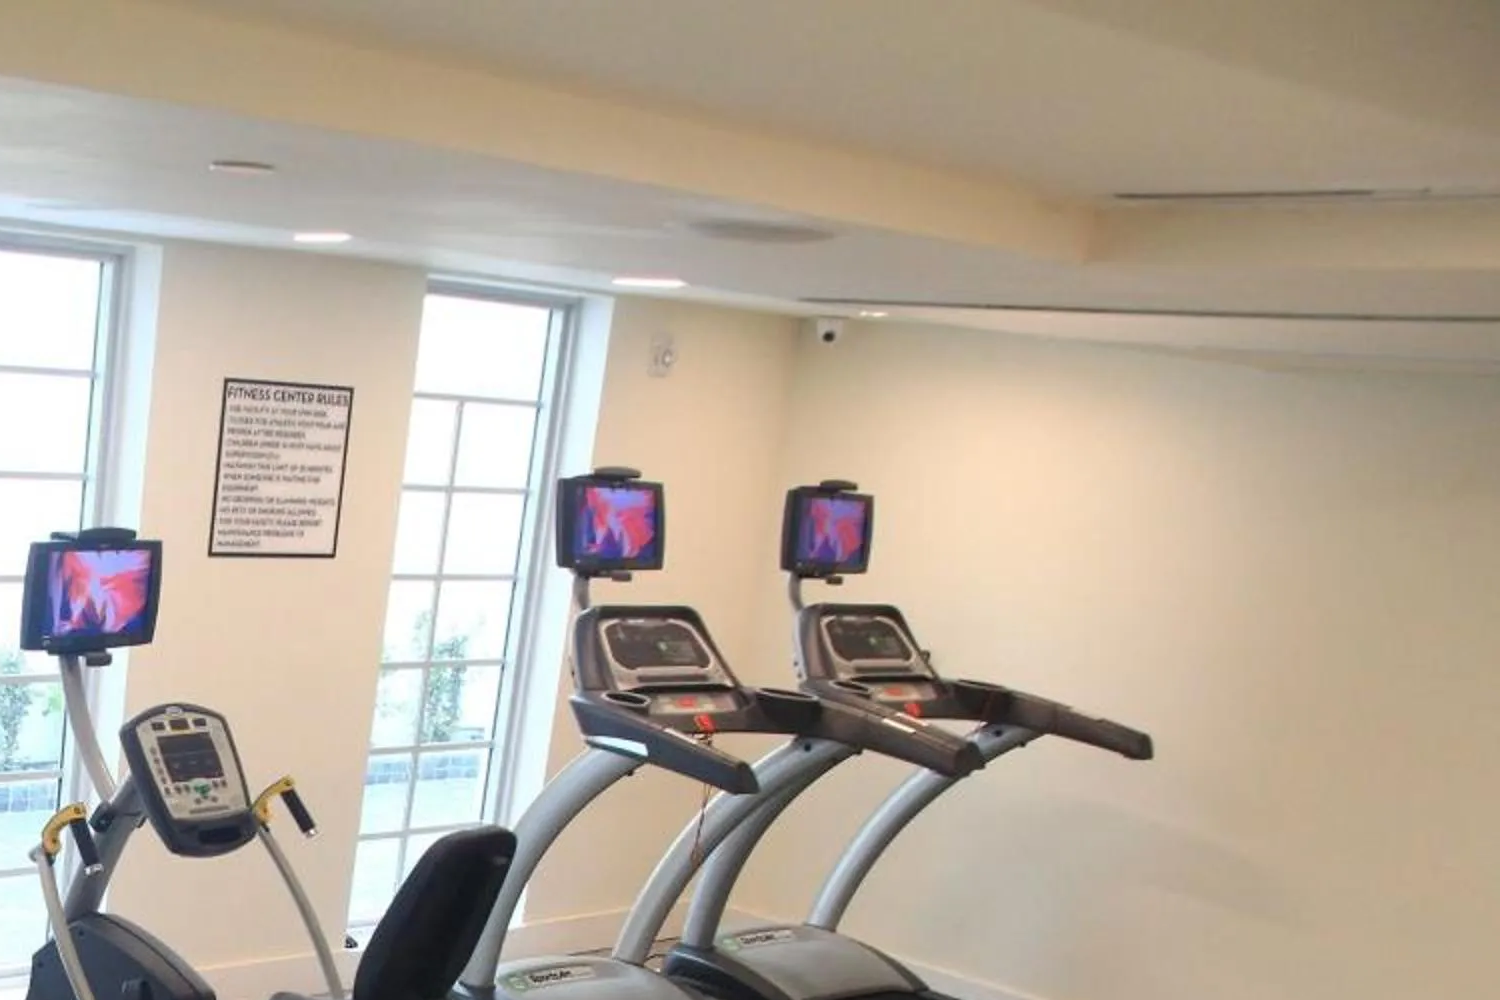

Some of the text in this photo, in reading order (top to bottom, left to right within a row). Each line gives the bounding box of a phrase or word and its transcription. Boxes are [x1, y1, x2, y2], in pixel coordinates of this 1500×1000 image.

[227, 386, 348, 406] FITNESS CENTER RULES
